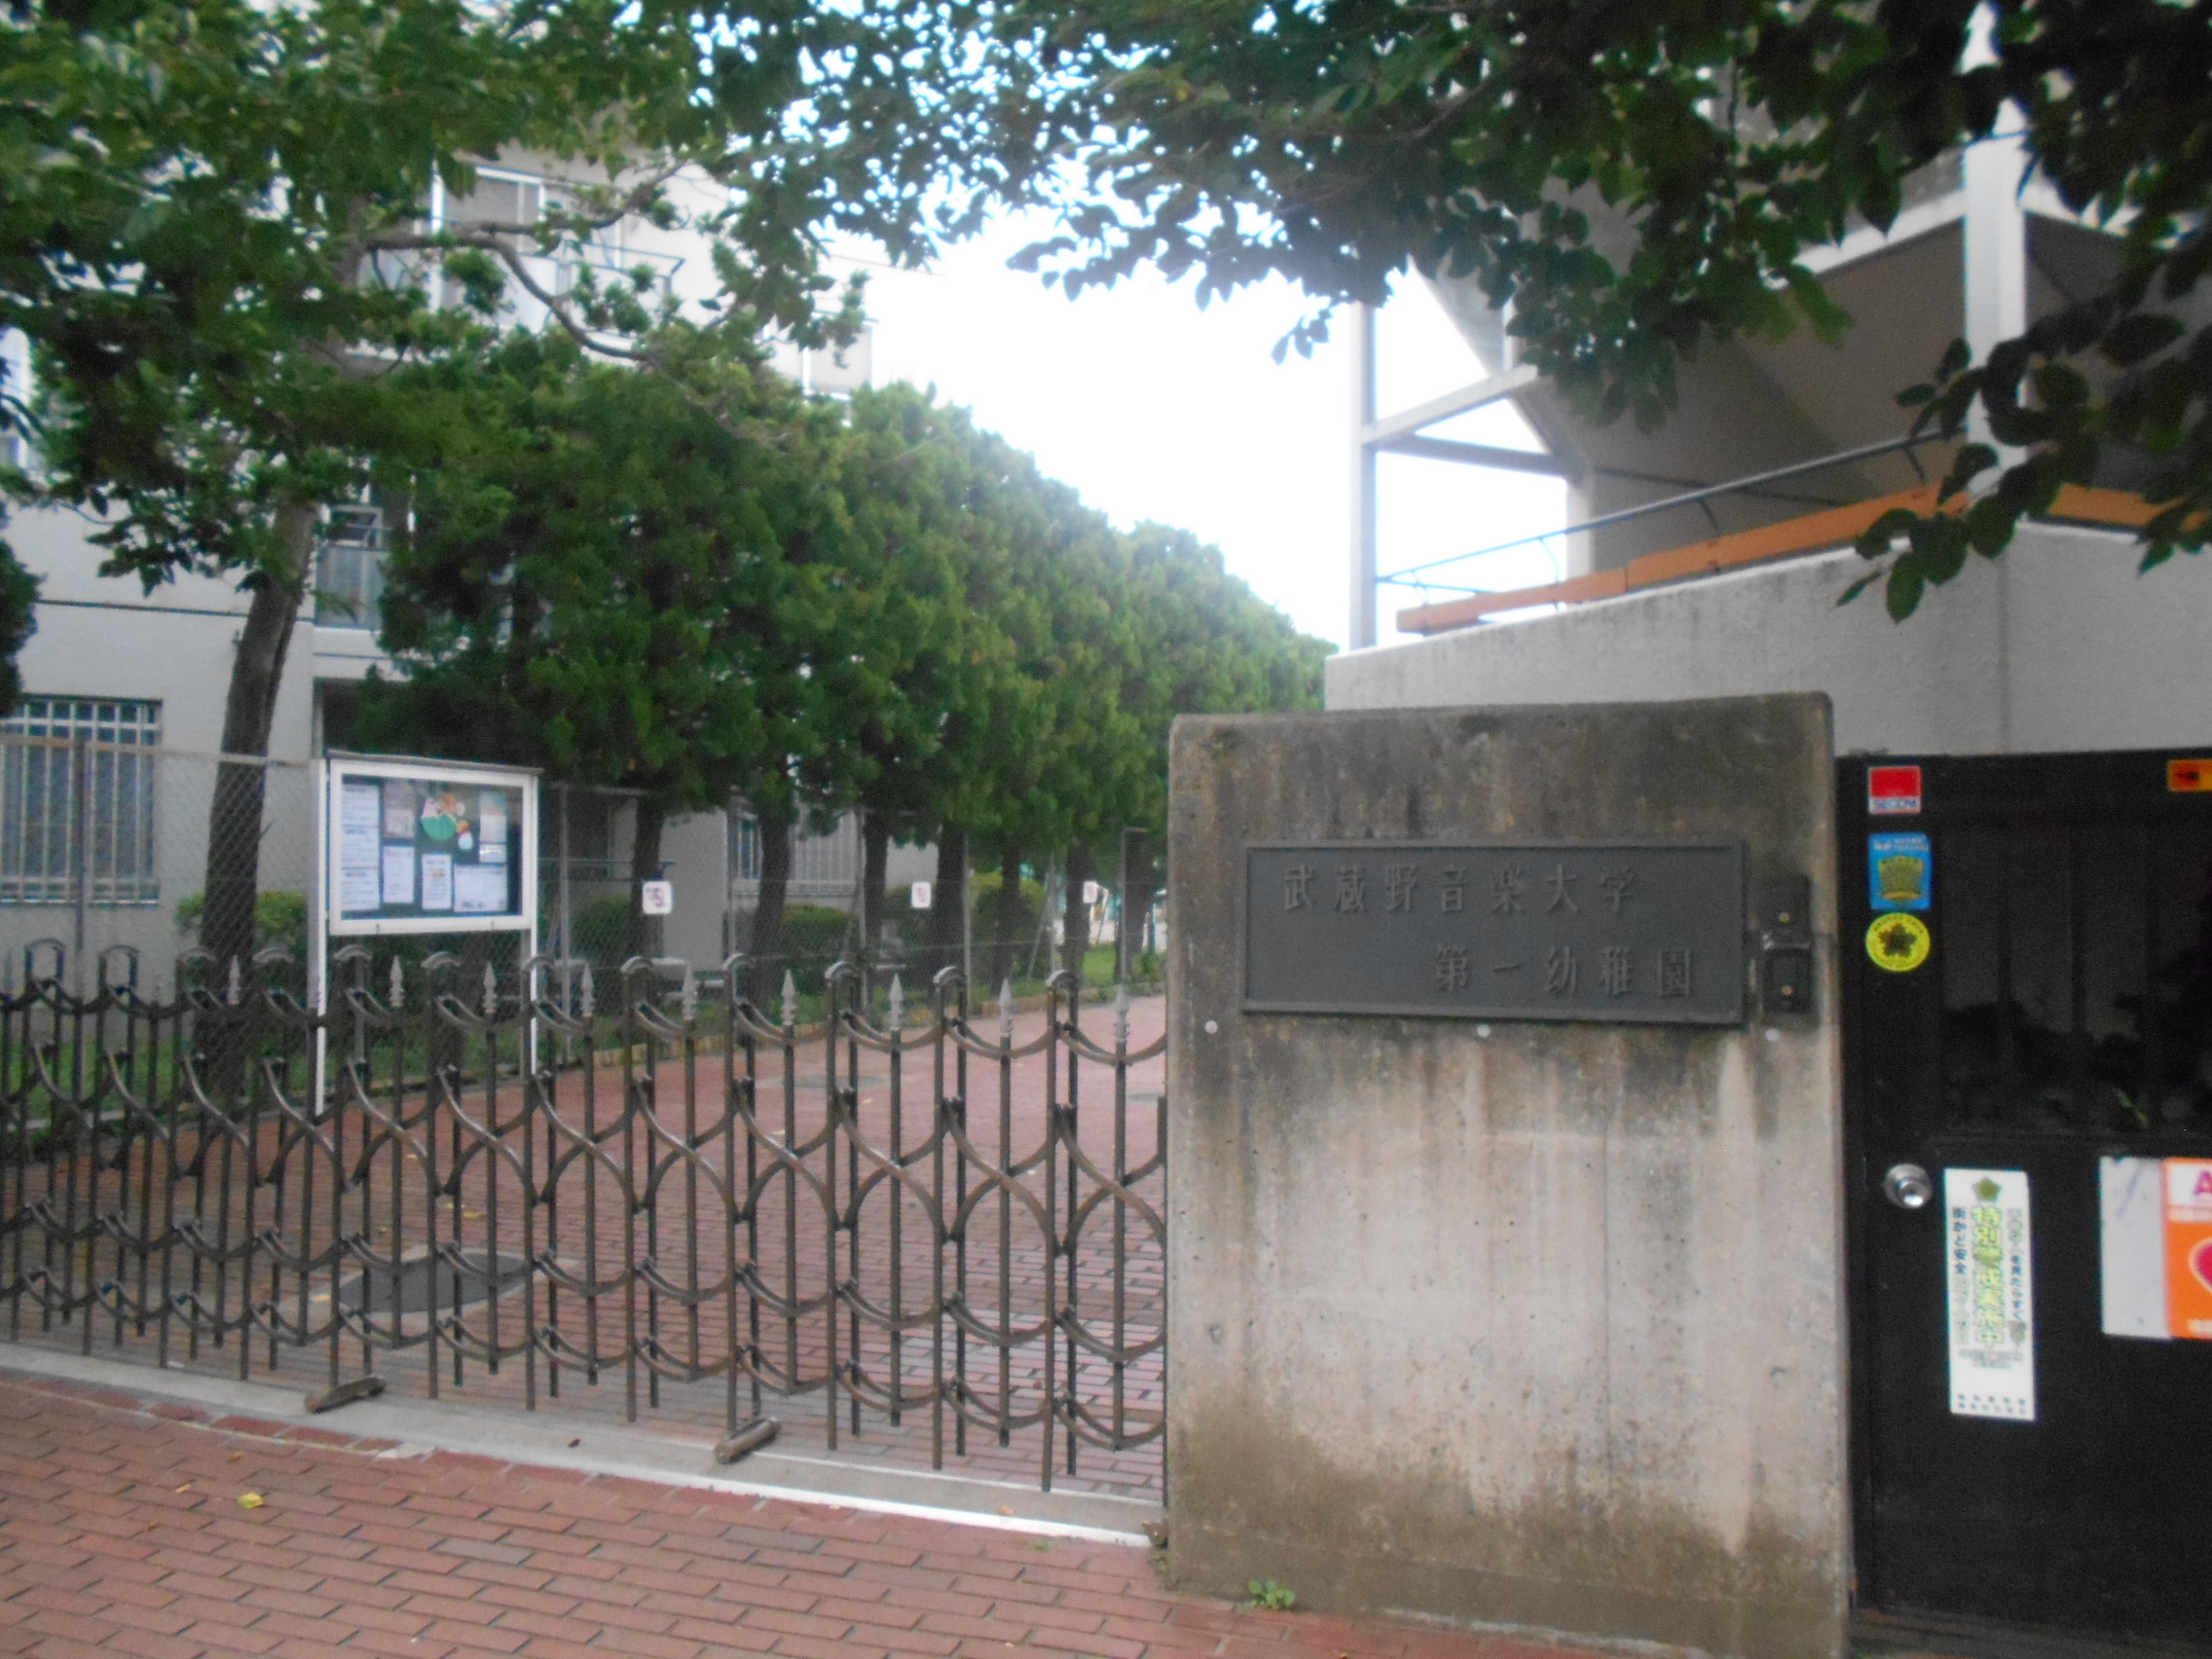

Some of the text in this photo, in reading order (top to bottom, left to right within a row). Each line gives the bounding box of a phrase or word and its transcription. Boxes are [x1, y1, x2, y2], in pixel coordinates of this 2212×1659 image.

[1283, 863, 1637, 913] 武蔵野音楽大学
[1435, 943, 1692, 997] 第一幼稚園
